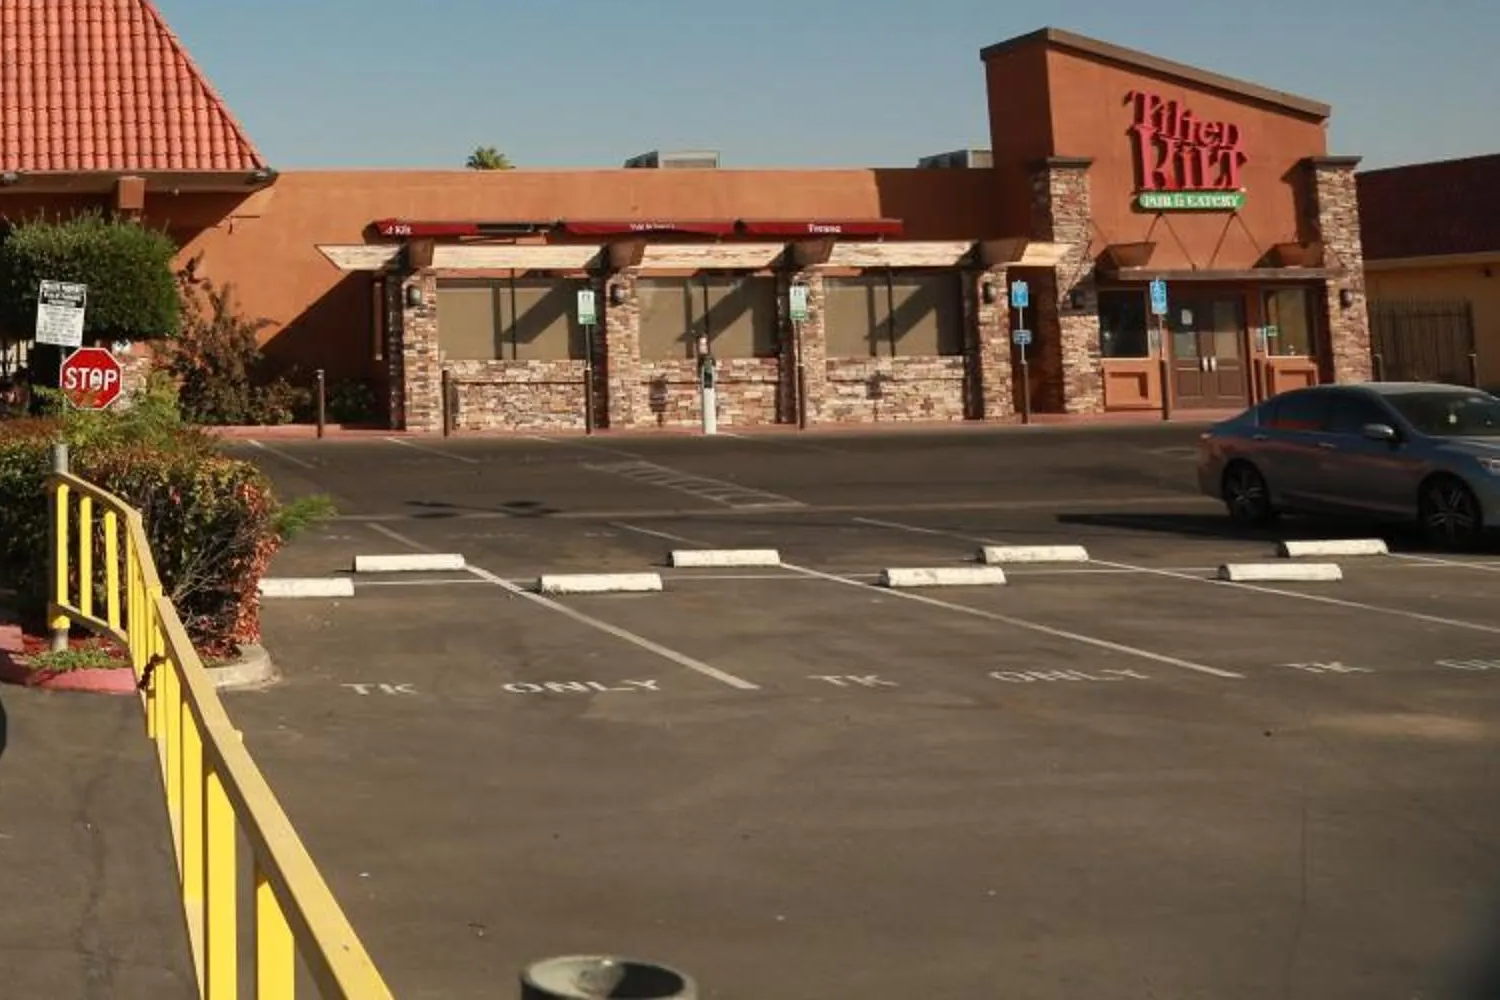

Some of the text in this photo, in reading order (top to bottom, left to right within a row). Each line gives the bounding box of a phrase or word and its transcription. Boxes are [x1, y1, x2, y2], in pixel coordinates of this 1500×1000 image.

[64, 366, 118, 392] STOP
[339, 678, 662, 696] TK ONLY
